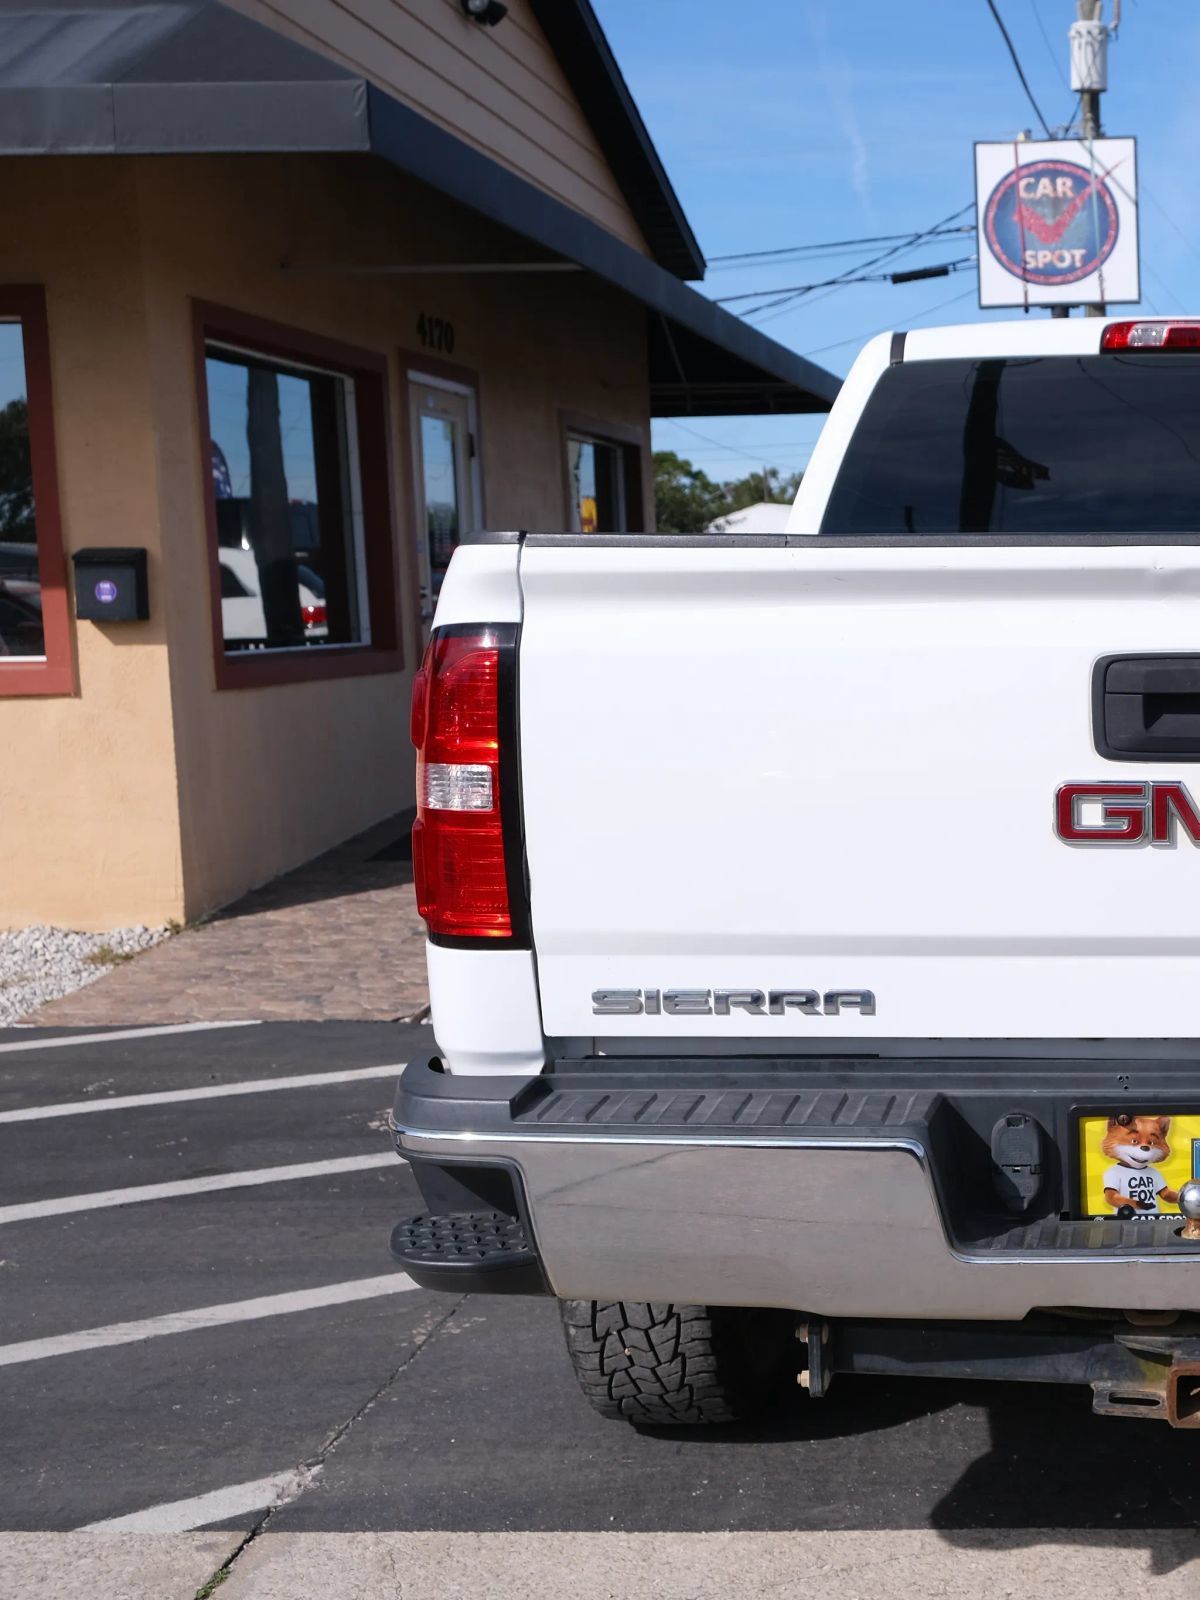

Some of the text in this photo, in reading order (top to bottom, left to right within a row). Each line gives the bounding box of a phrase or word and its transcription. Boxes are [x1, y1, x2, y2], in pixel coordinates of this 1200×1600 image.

[1019, 177, 1075, 199] CAR
[1024, 249, 1086, 269] SPOT
[416, 310, 455, 354] 4170
[591, 988, 877, 1016] SIERRA
[1128, 1176, 1154, 1189] CAR
[1129, 1189, 1155, 1202] FOX
